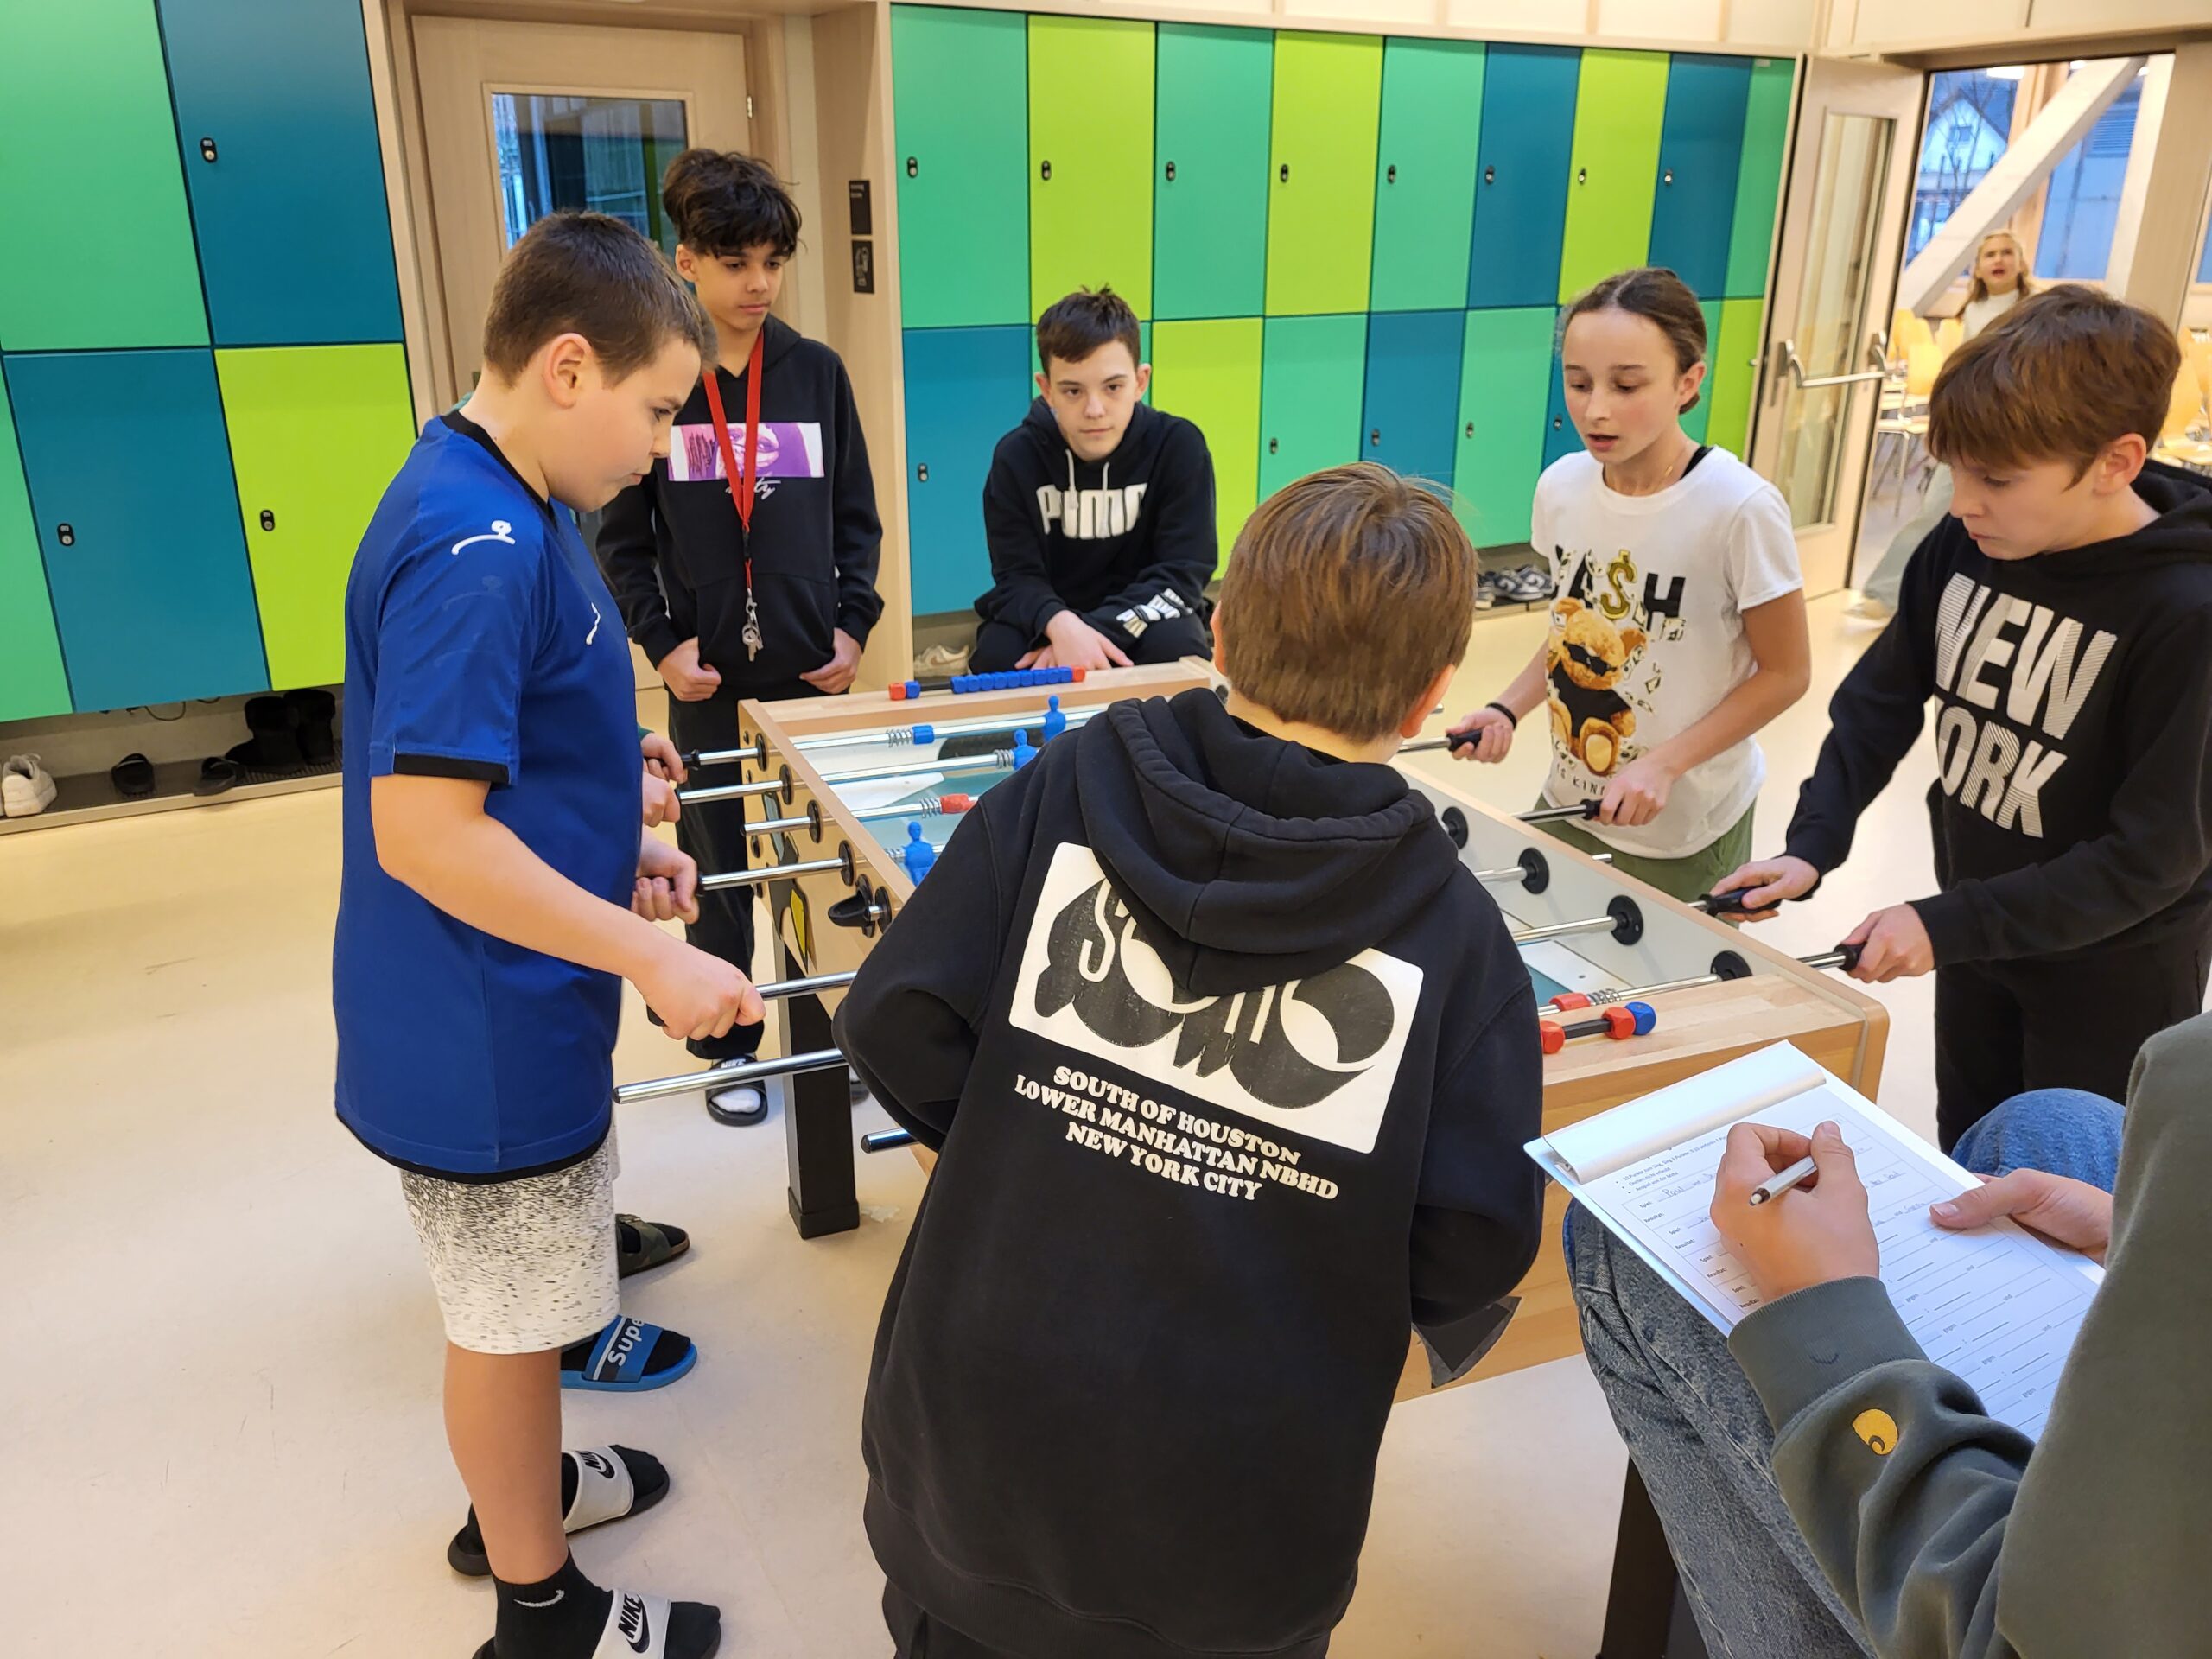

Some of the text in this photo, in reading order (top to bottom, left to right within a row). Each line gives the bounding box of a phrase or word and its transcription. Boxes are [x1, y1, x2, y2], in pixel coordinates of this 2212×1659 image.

[1936, 571, 2118, 741] NEW
[1934, 694, 2068, 838] ORK
[1014, 1074, 1339, 1199] LOWER MANHATTAN NBHD
[1053, 1065, 1301, 1166] SOUTH OF HOUSTON
[1065, 1121, 1262, 1200] NEW YORK CITY
[618, 1592, 642, 1640] NIKE
